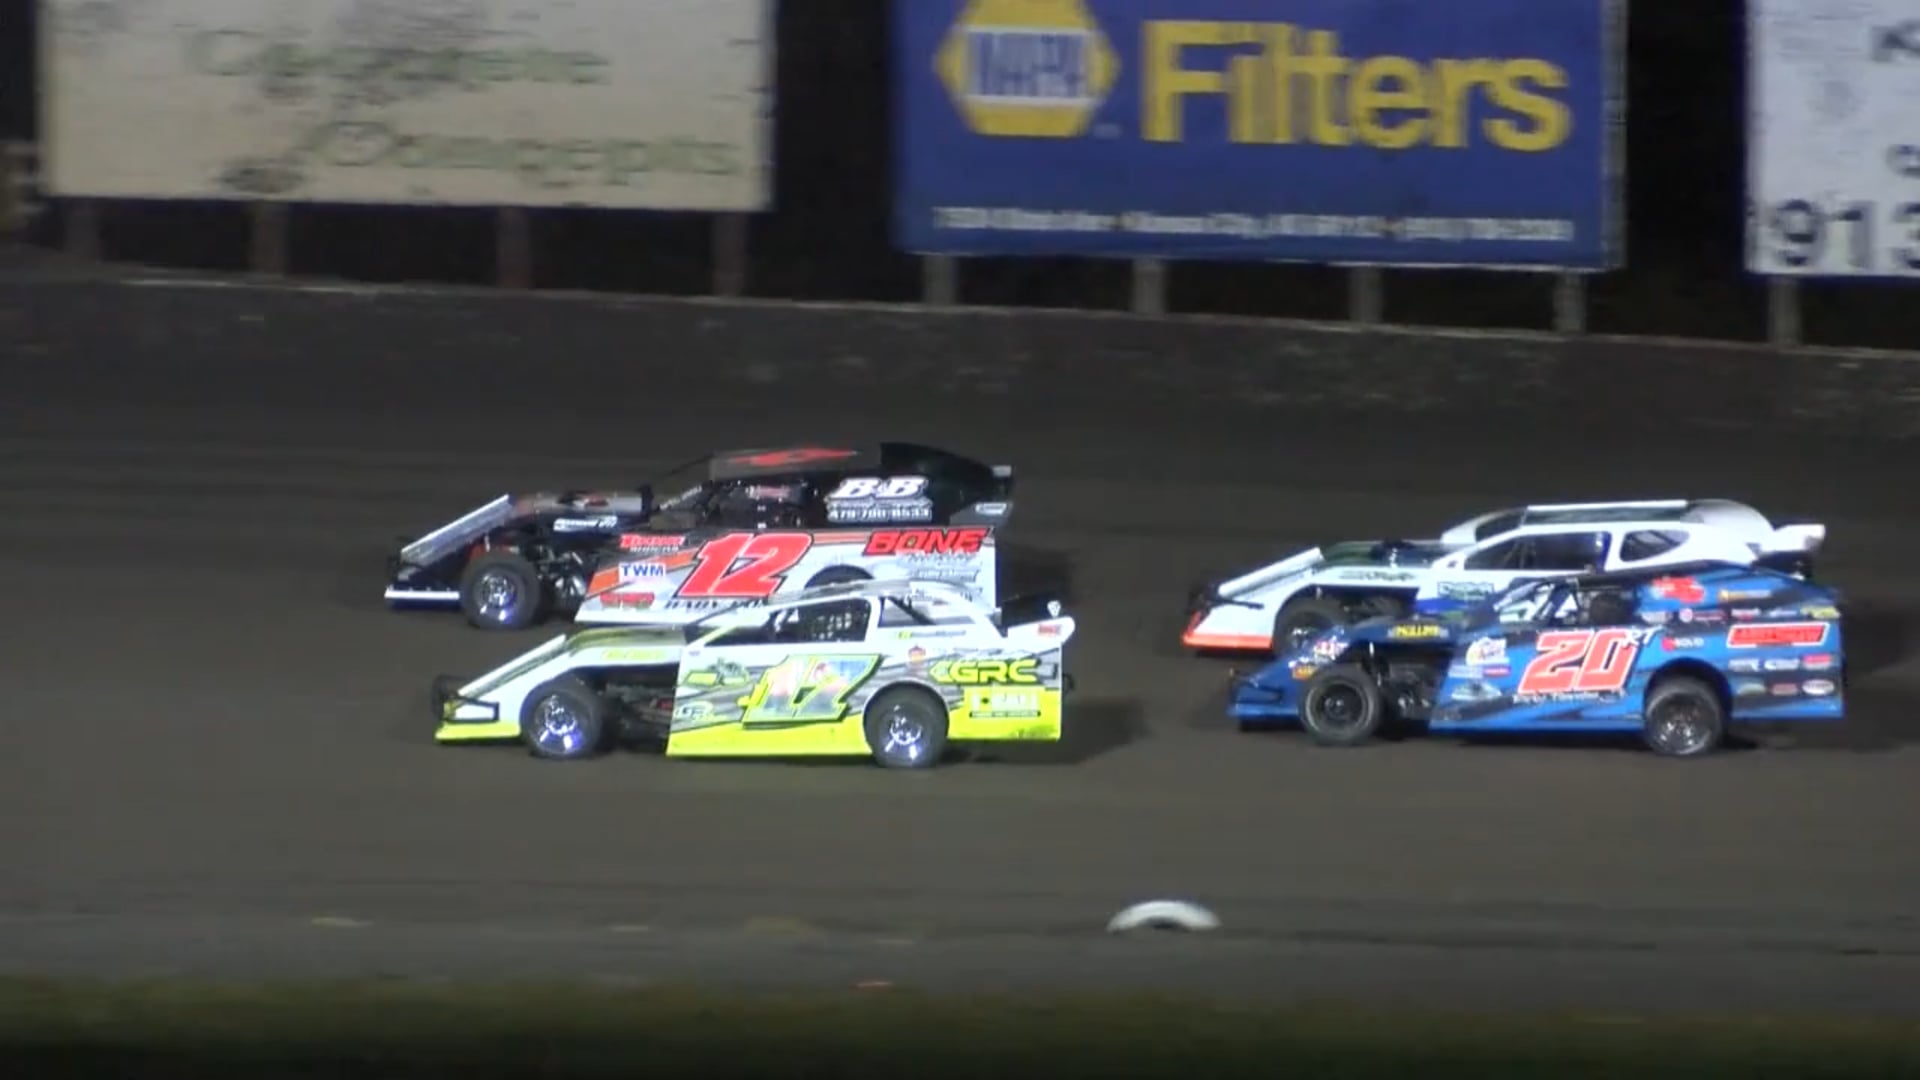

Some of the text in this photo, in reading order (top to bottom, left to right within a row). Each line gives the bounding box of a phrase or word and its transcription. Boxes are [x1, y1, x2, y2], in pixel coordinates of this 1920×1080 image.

[1141, 21, 1573, 151] Filters
[621, 563, 664, 577] TWM
[673, 531, 816, 598] 12
[863, 528, 996, 555] BONE
[742, 654, 880, 728] 17
[947, 659, 1038, 683] GRC
[1517, 628, 1638, 694] 20
